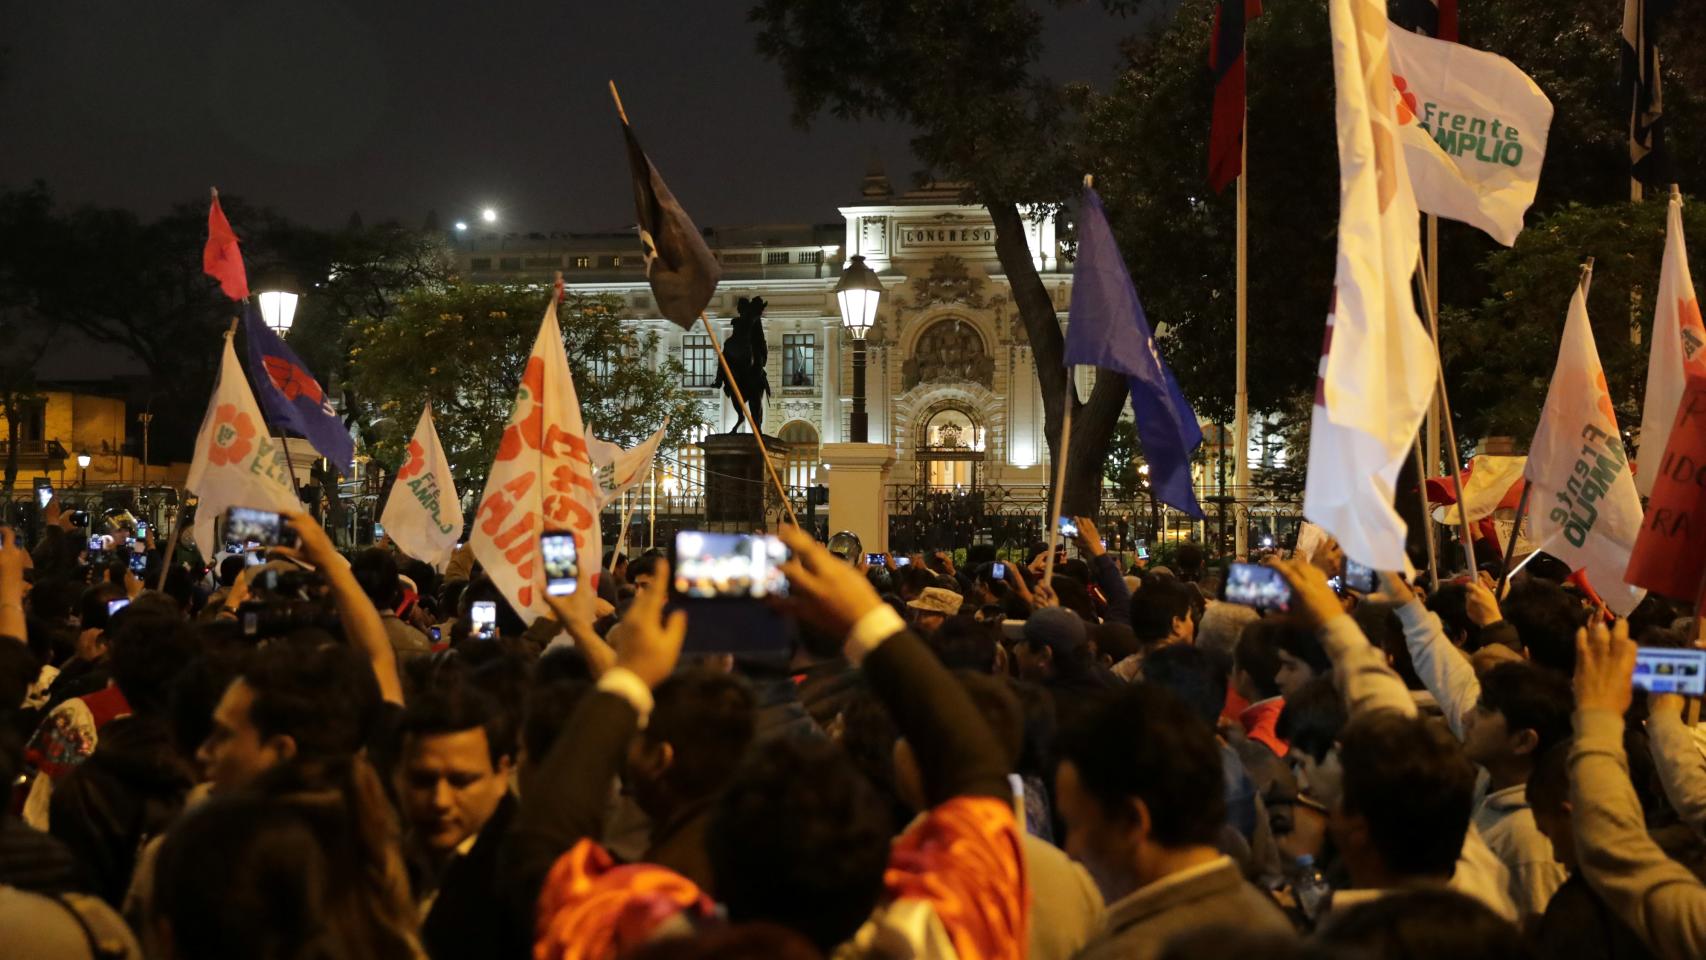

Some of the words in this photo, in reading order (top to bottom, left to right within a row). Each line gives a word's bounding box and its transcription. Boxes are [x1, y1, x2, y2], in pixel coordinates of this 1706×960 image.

[1424, 102, 1519, 141] Frente
[906, 229, 991, 242] CONGRESO
[421, 471, 441, 501] Fre
[407, 478, 453, 535] AMPLO
